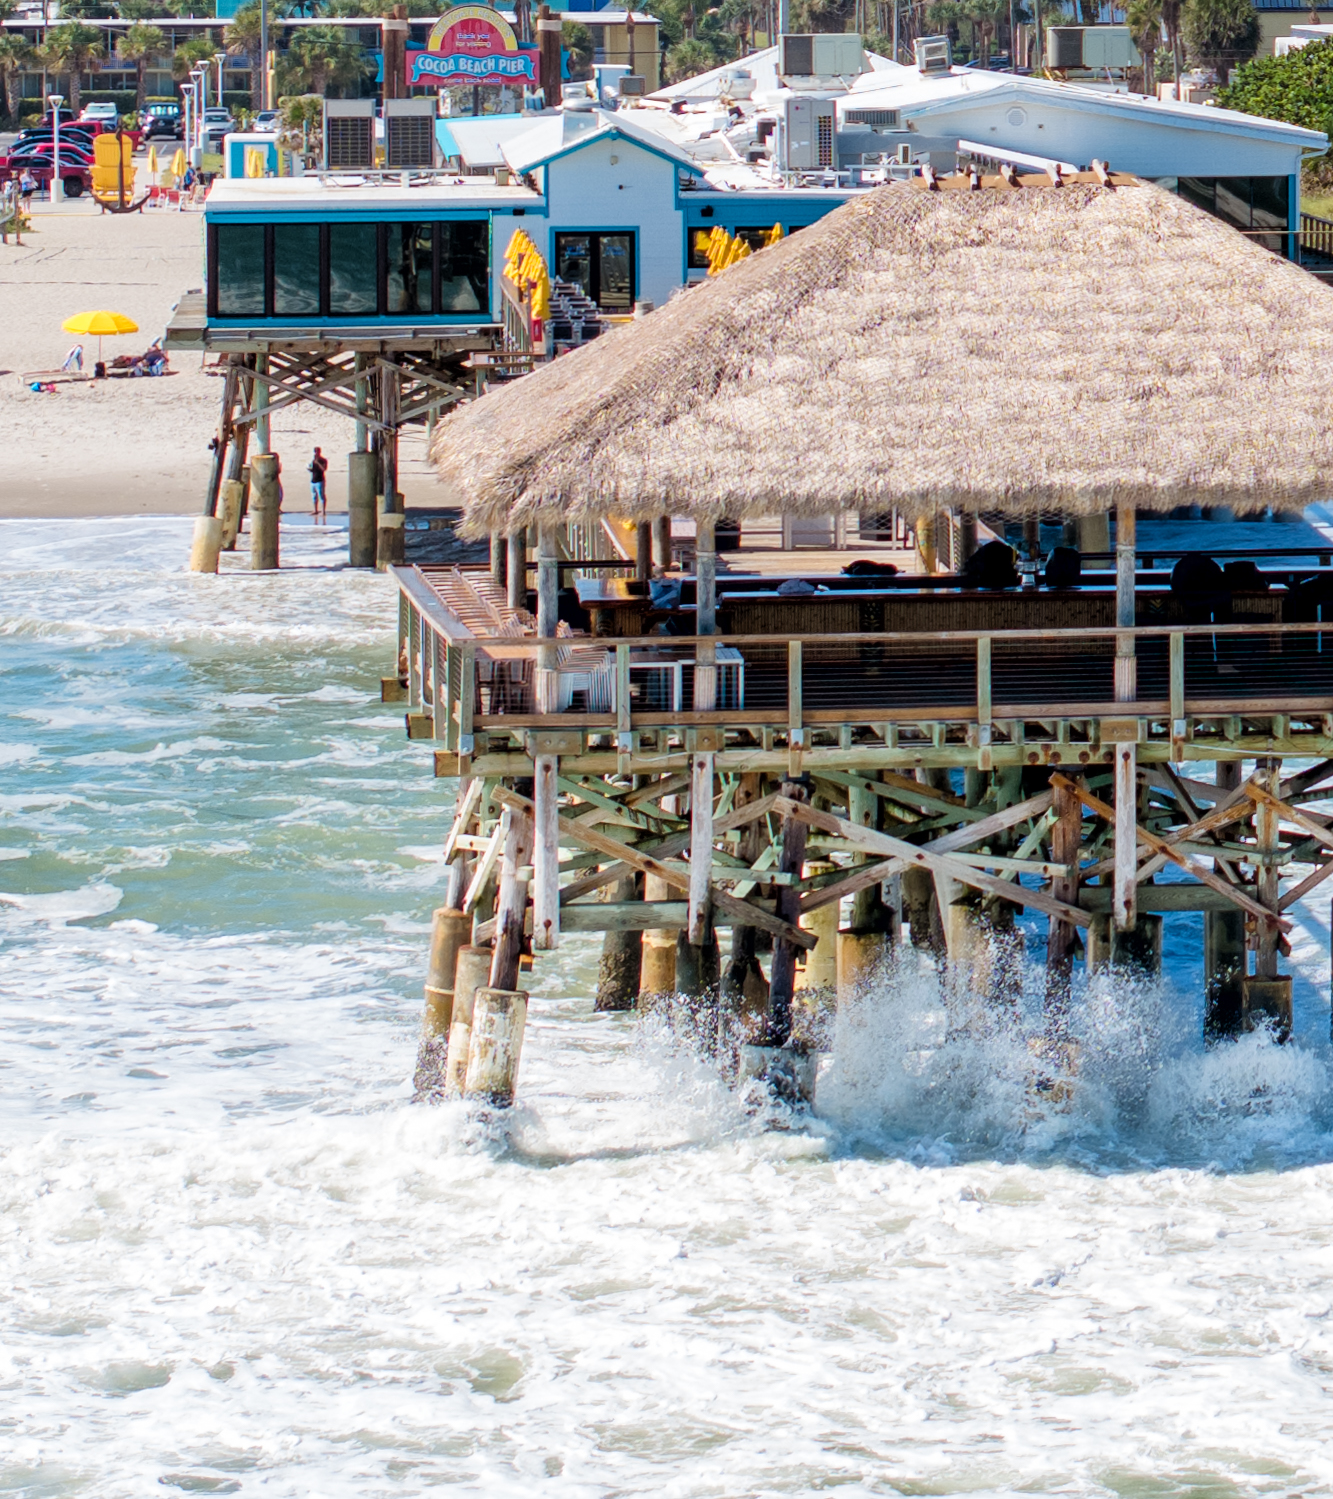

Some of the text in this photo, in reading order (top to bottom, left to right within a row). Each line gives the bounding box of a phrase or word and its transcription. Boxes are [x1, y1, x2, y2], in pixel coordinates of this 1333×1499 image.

[418, 56, 525, 73] COCOA BEACH PIER
